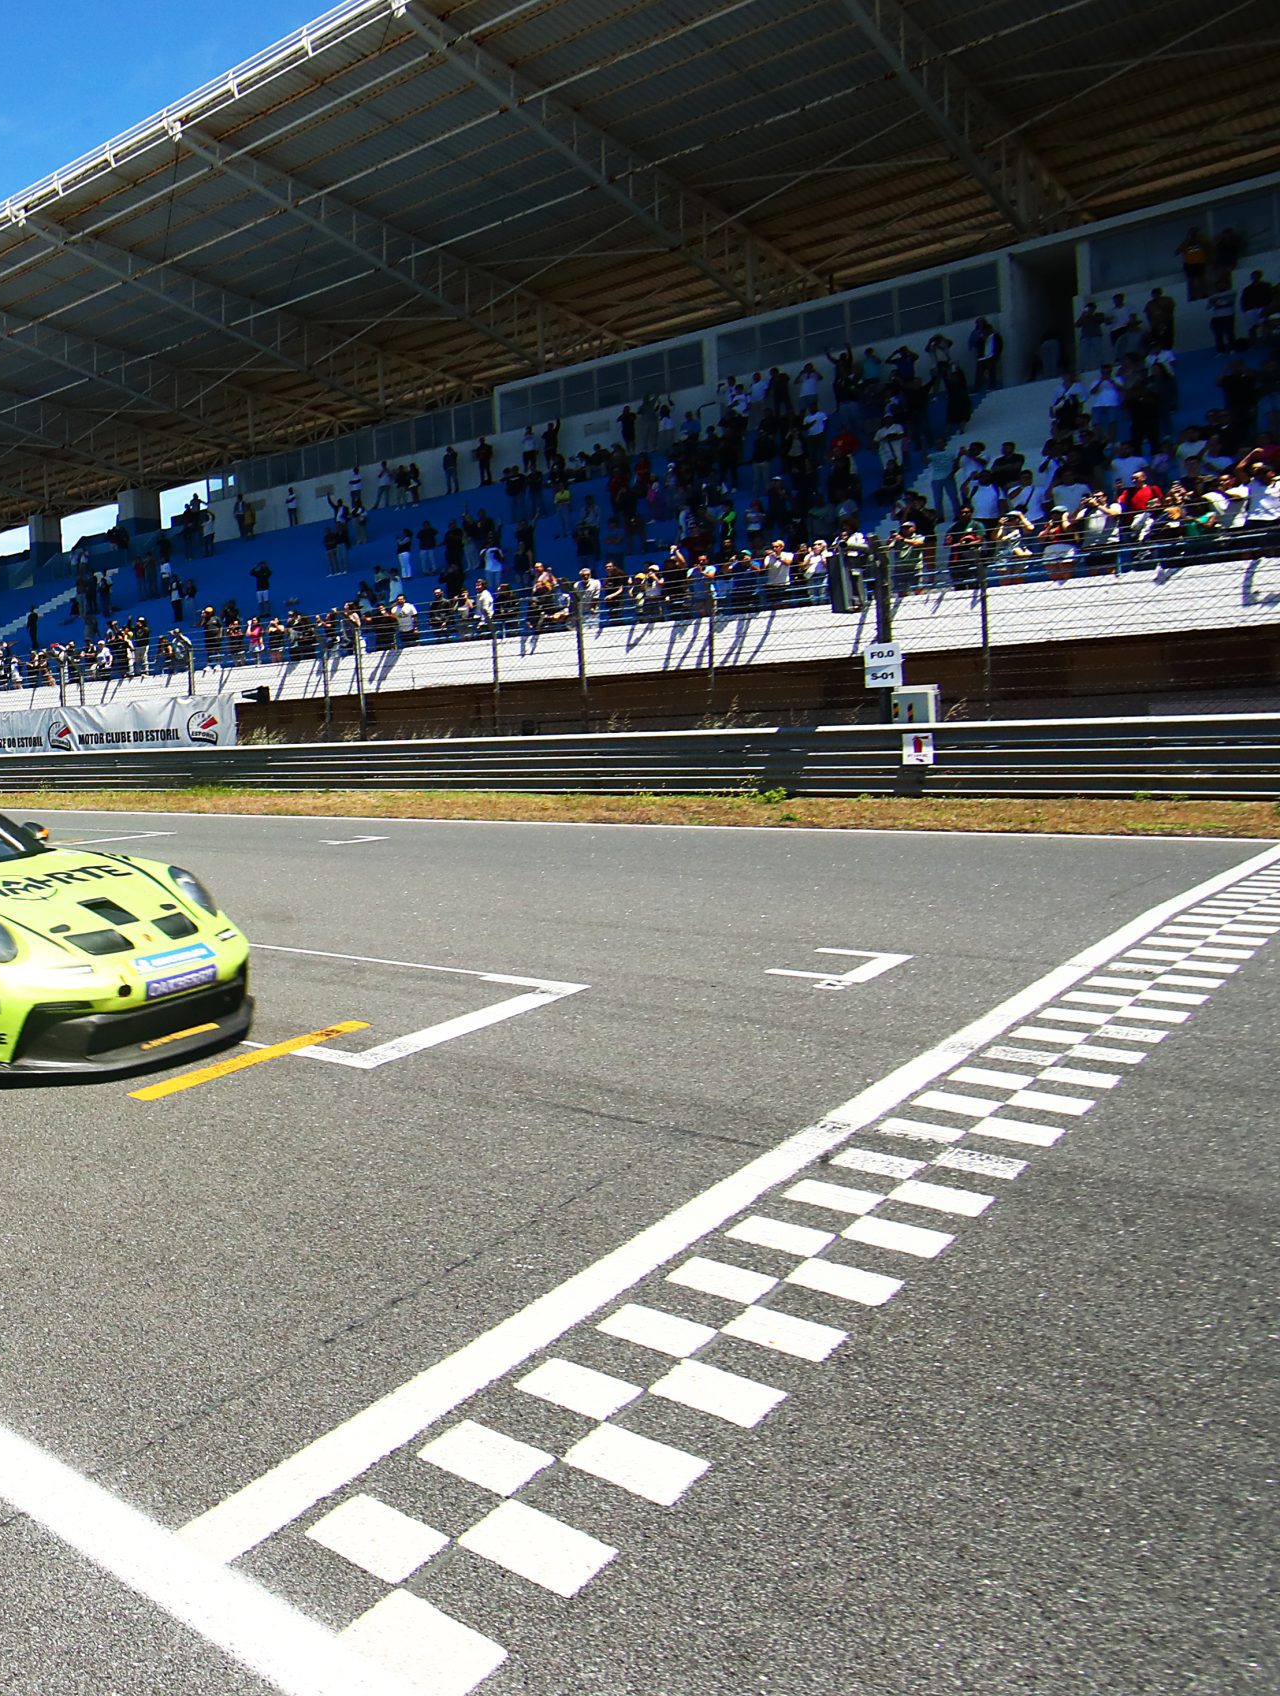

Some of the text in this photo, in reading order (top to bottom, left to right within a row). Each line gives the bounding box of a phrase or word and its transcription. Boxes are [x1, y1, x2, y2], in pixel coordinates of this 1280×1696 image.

[871, 672, 894, 680] S-01
[78, 728, 180, 745] MOTOR CLUBE DO ESTORIL
[191, 730, 217, 741] ESTORIL
[17, 736, 43, 748] ESTORIL
